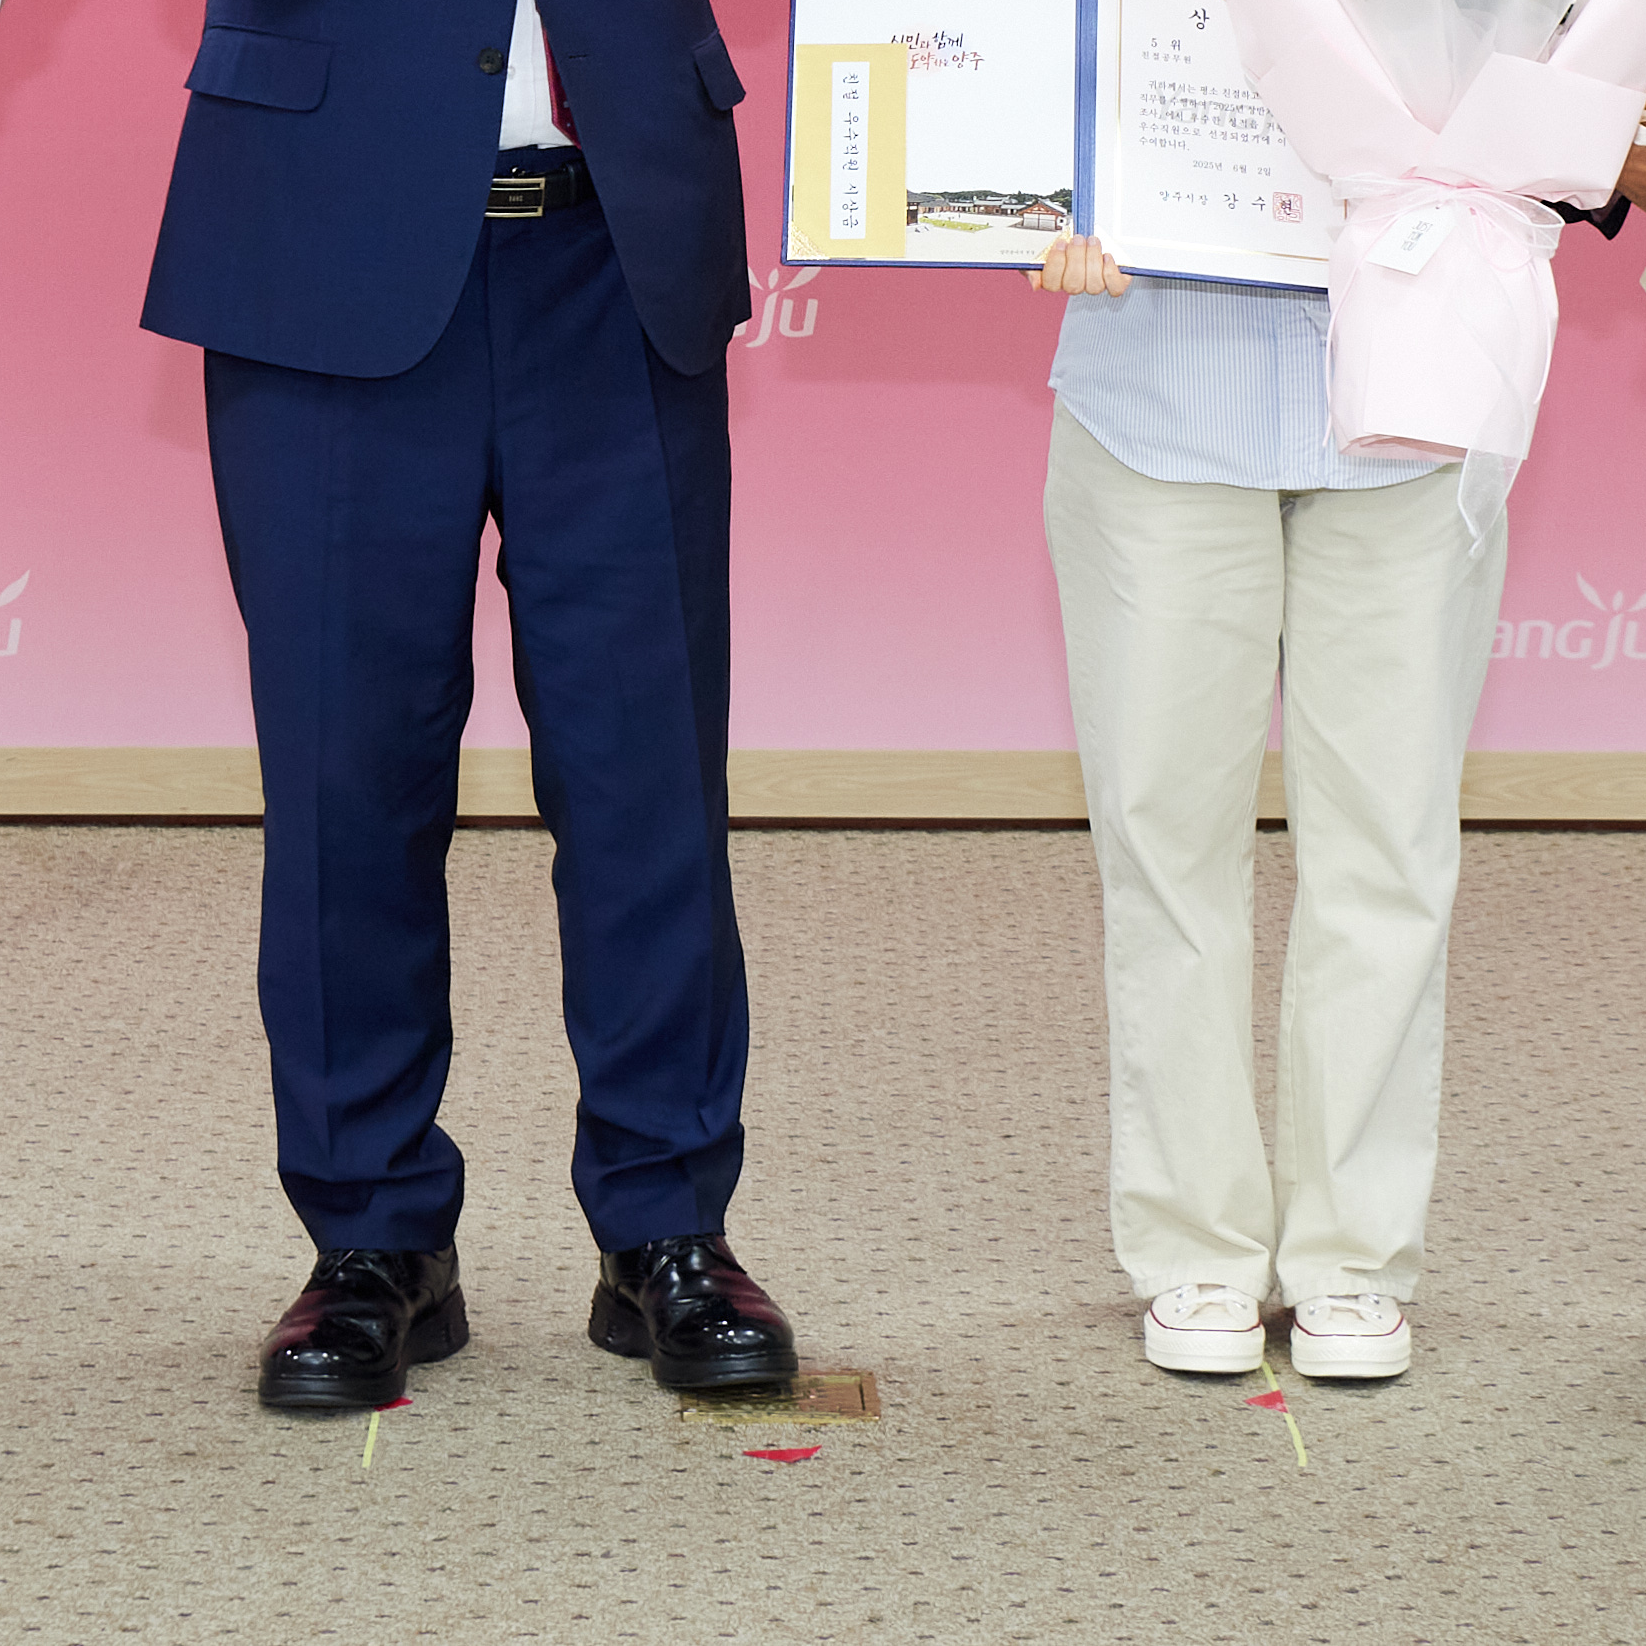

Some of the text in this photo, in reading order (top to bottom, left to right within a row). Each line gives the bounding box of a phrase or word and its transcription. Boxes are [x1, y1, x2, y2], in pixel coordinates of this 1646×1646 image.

[1188, 8, 1210, 30] 상
[932, 31, 963, 49] 함께
[1151, 38, 1181, 51] 5 위
[952, 51, 985, 70] 양주
[842, 73, 859, 229] 친절 우수직원 시상금
[1192, 160, 1222, 171] 2025년
[1159, 190, 1208, 205] 양주시장
[1223, 193, 1239, 209] 강
[1251, 196, 1266, 211] 수
